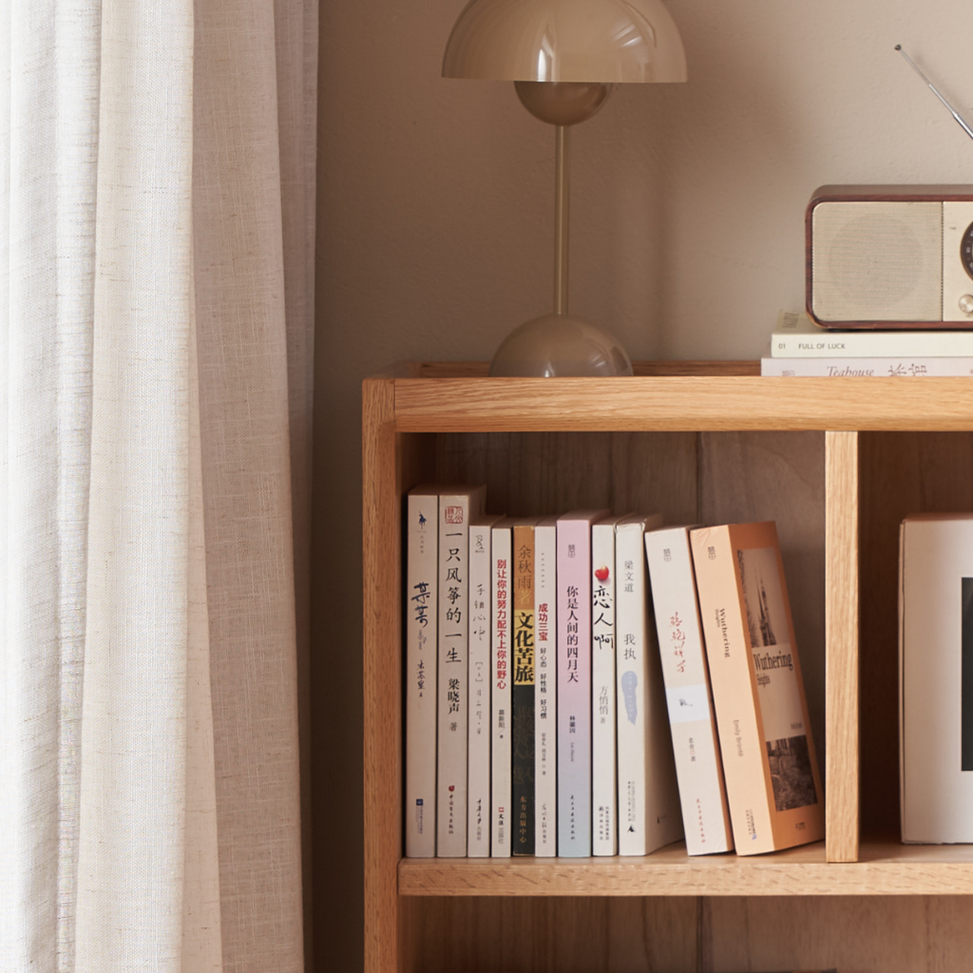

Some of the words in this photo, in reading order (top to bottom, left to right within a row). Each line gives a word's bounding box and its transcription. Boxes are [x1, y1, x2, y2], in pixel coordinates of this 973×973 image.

[826, 365, 875, 376] Teahouse
[624, 560, 634, 593] 梁文道
[445, 531, 463, 664] 一只风筝的一生
[496, 558, 508, 690] 别让你的努力配不上你的野心
[538, 603, 549, 642] 成功三宝
[566, 585, 579, 684] 你是人间的四月天
[593, 585, 614, 651] 恋人啊
[719, 607, 731, 658] Wuthering
[514, 611, 534, 683] 文化苦旅
[623, 633, 637, 661] 我执
[753, 650, 794, 671] Wuthering
[447, 678, 460, 715] 梁晓声
[598, 685, 609, 716] 方悄悄
[448, 722, 458, 732] 著
[519, 795, 527, 844] 东方出版中心
